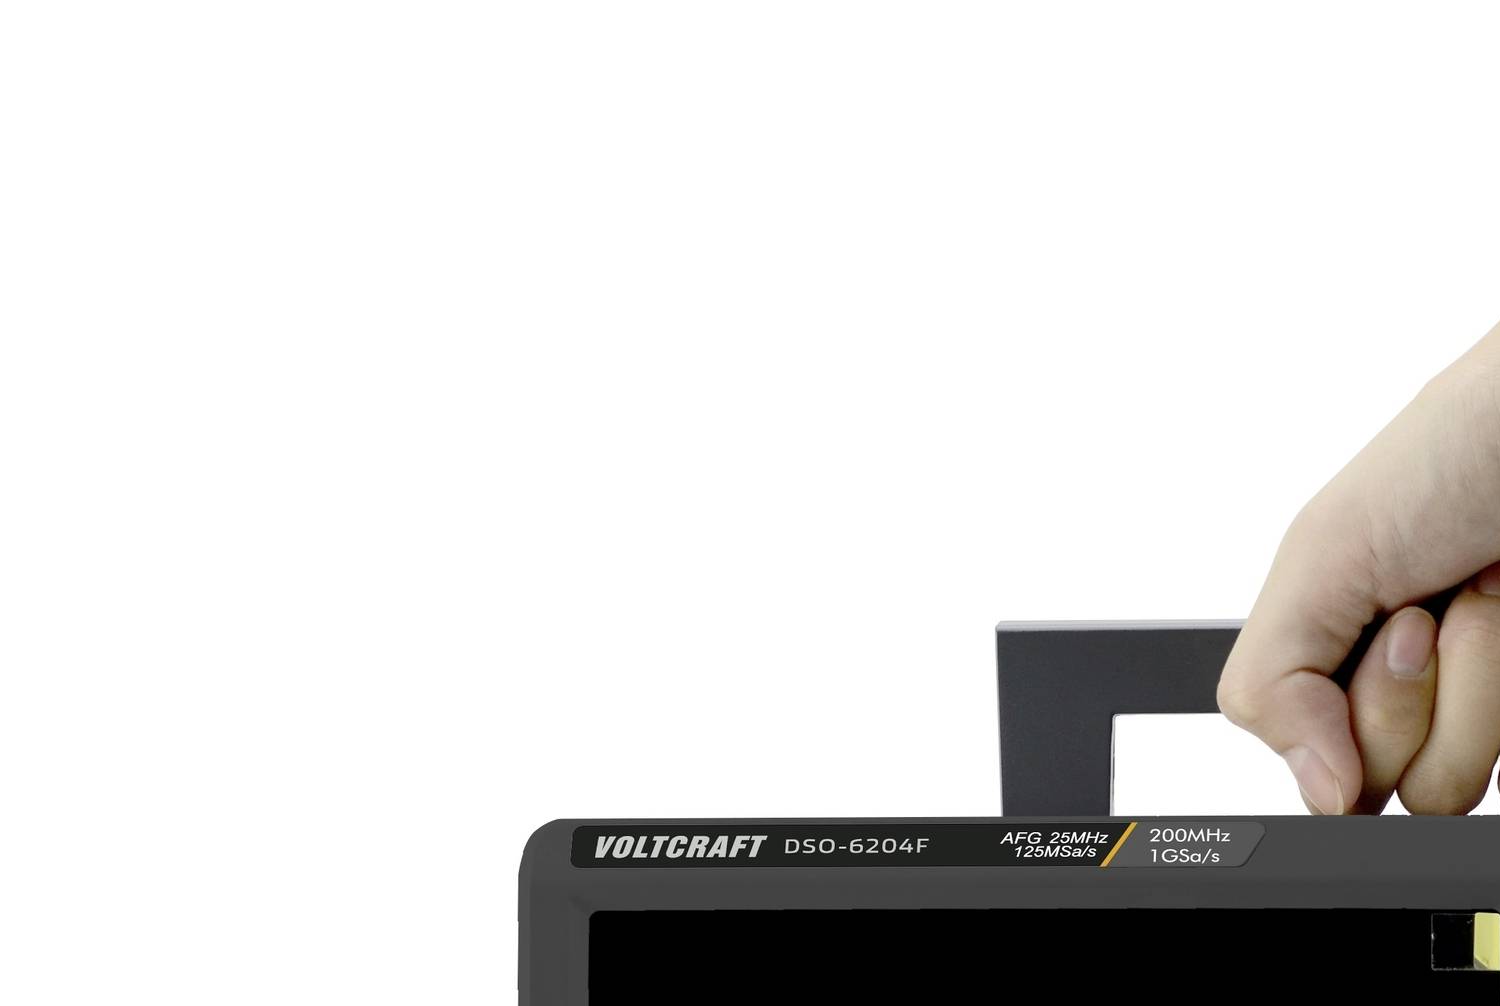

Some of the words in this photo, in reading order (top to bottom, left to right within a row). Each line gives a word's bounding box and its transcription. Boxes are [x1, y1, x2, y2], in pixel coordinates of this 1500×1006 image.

[1000, 832, 1042, 844] AFG
[1049, 832, 1108, 844] 25MHz
[1150, 829, 1230, 842] 200MHz
[595, 836, 767, 858] VOLTCRAFT
[785, 839, 929, 853] DSO-6204F
[1015, 846, 1096, 857] 125MSa/s
[1152, 849, 1219, 863] 1GSa/s
